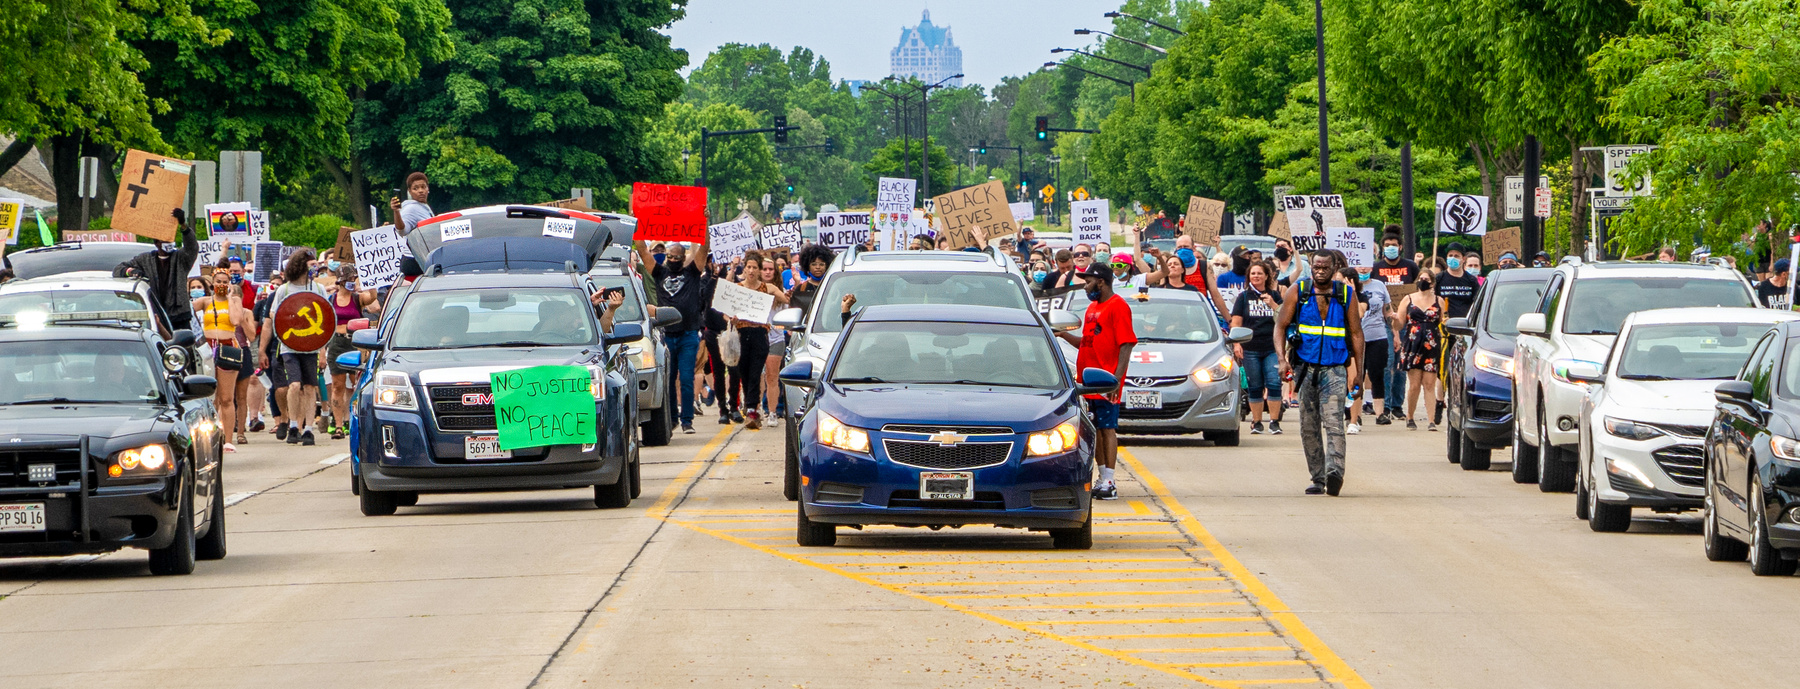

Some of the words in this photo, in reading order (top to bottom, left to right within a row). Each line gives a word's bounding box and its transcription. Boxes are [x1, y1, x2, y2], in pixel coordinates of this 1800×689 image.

[1610, 149, 1644, 157] SPEE
[1614, 160, 1631, 168] LIM
[639, 185, 687, 202] Silence
[881, 181, 909, 193] BLACK
[880, 194, 909, 203] LIVES
[939, 185, 998, 215] BLACK
[1285, 197, 1305, 208] END
[1310, 195, 1342, 208] POLICE
[878, 203, 912, 213] MATTER
[1190, 198, 1221, 218] BLACK
[819, 216, 834, 227] NO
[839, 214, 870, 225] JUSTICE
[944, 208, 993, 230] LIVES
[1189, 217, 1216, 230] LIVES
[640, 218, 705, 238] VIOLENCE
[709, 222, 745, 238] RACISM
[762, 222, 800, 239] BLACK
[353, 233, 387, 248] We're
[732, 232, 752, 241] SMALL
[769, 234, 796, 247] LIVES
[820, 232, 834, 245] NO
[838, 230, 868, 245] PEACE
[1336, 240, 1366, 249] JUSTICE
[356, 246, 396, 262] trying
[360, 259, 392, 278] START
[1379, 267, 1408, 276] BELIEVE
[1387, 275, 1401, 283] THE
[496, 373, 523, 392] NO
[527, 377, 592, 397] JUSTICE
[462, 393, 495, 405] GM
[501, 405, 526, 425] NO
[527, 412, 588, 441] PEACE
[14, 511, 26, 524] SQ
[31, 511, 42, 524] 16
